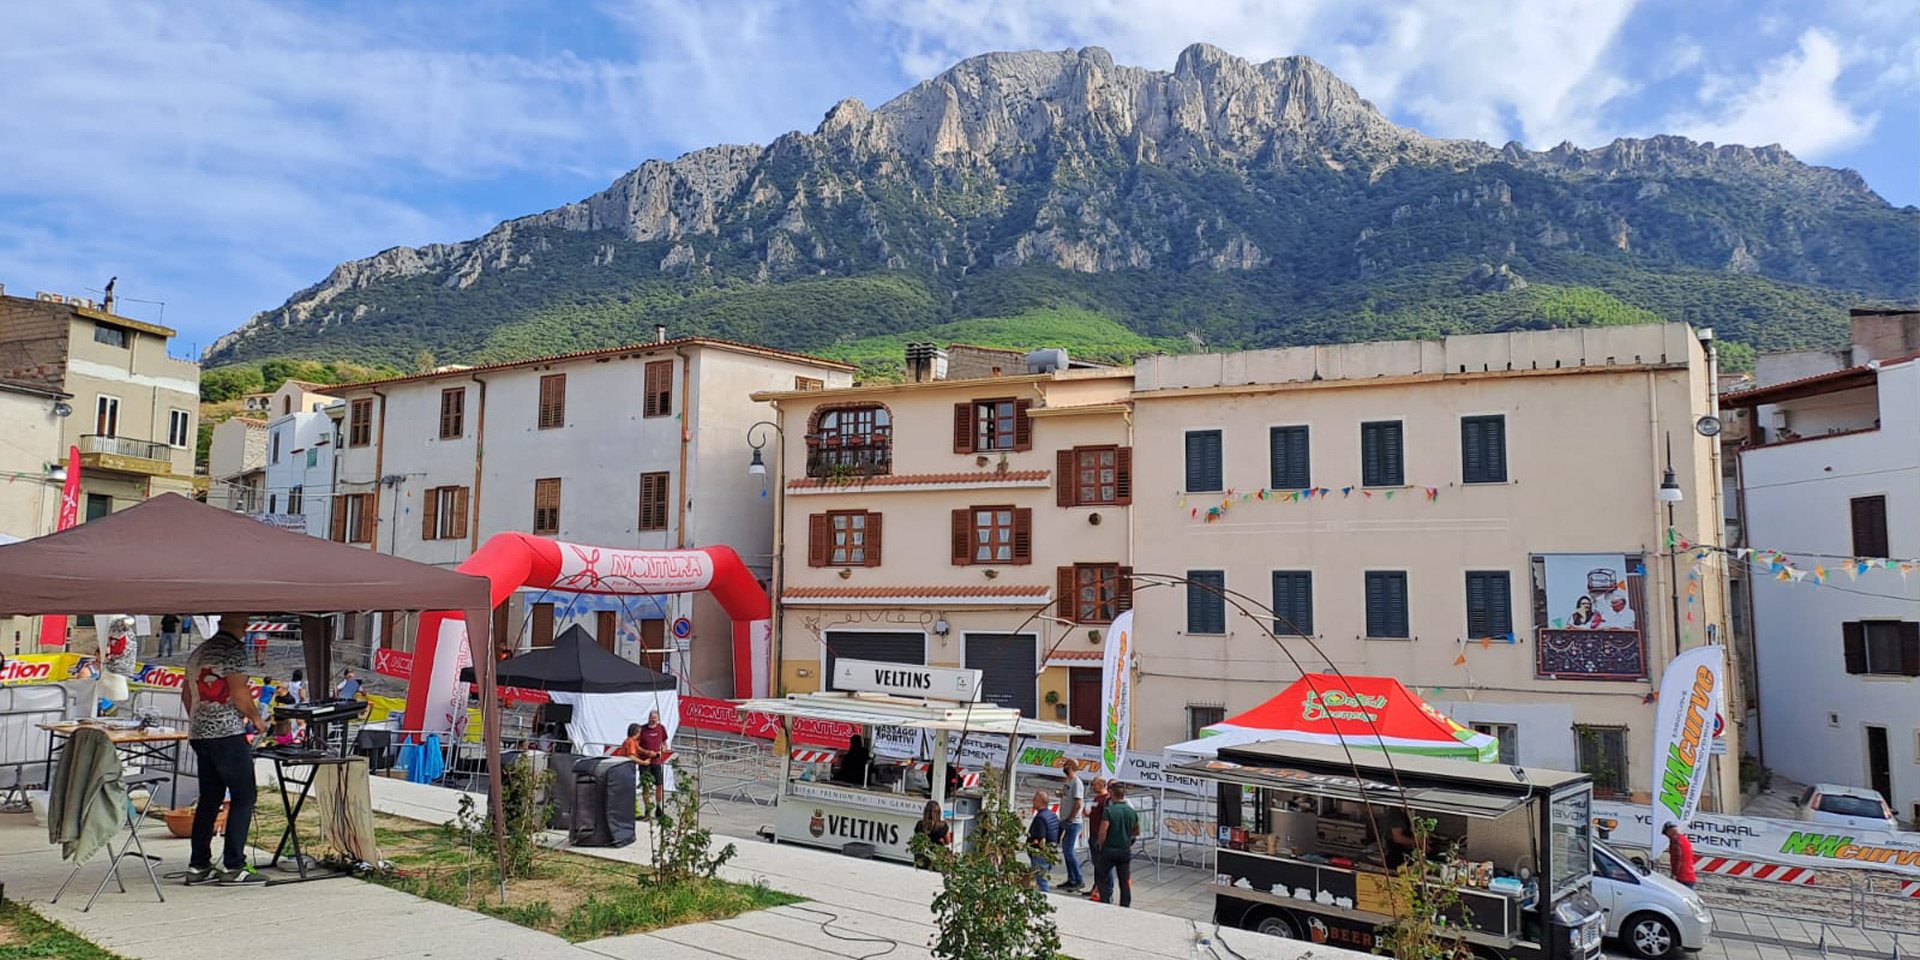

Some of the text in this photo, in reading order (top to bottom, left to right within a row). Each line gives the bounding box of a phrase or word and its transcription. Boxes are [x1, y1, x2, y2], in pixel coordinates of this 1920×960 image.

[611, 554, 703, 578] MONTURA
[875, 669, 931, 689] VELTINS
[686, 703, 756, 724] MONTU
[947, 748, 995, 760] OVEMENT
[1129, 759, 1160, 769] YOUR
[889, 801, 923, 811] GERMAN
[828, 814, 899, 845] VELTINS
